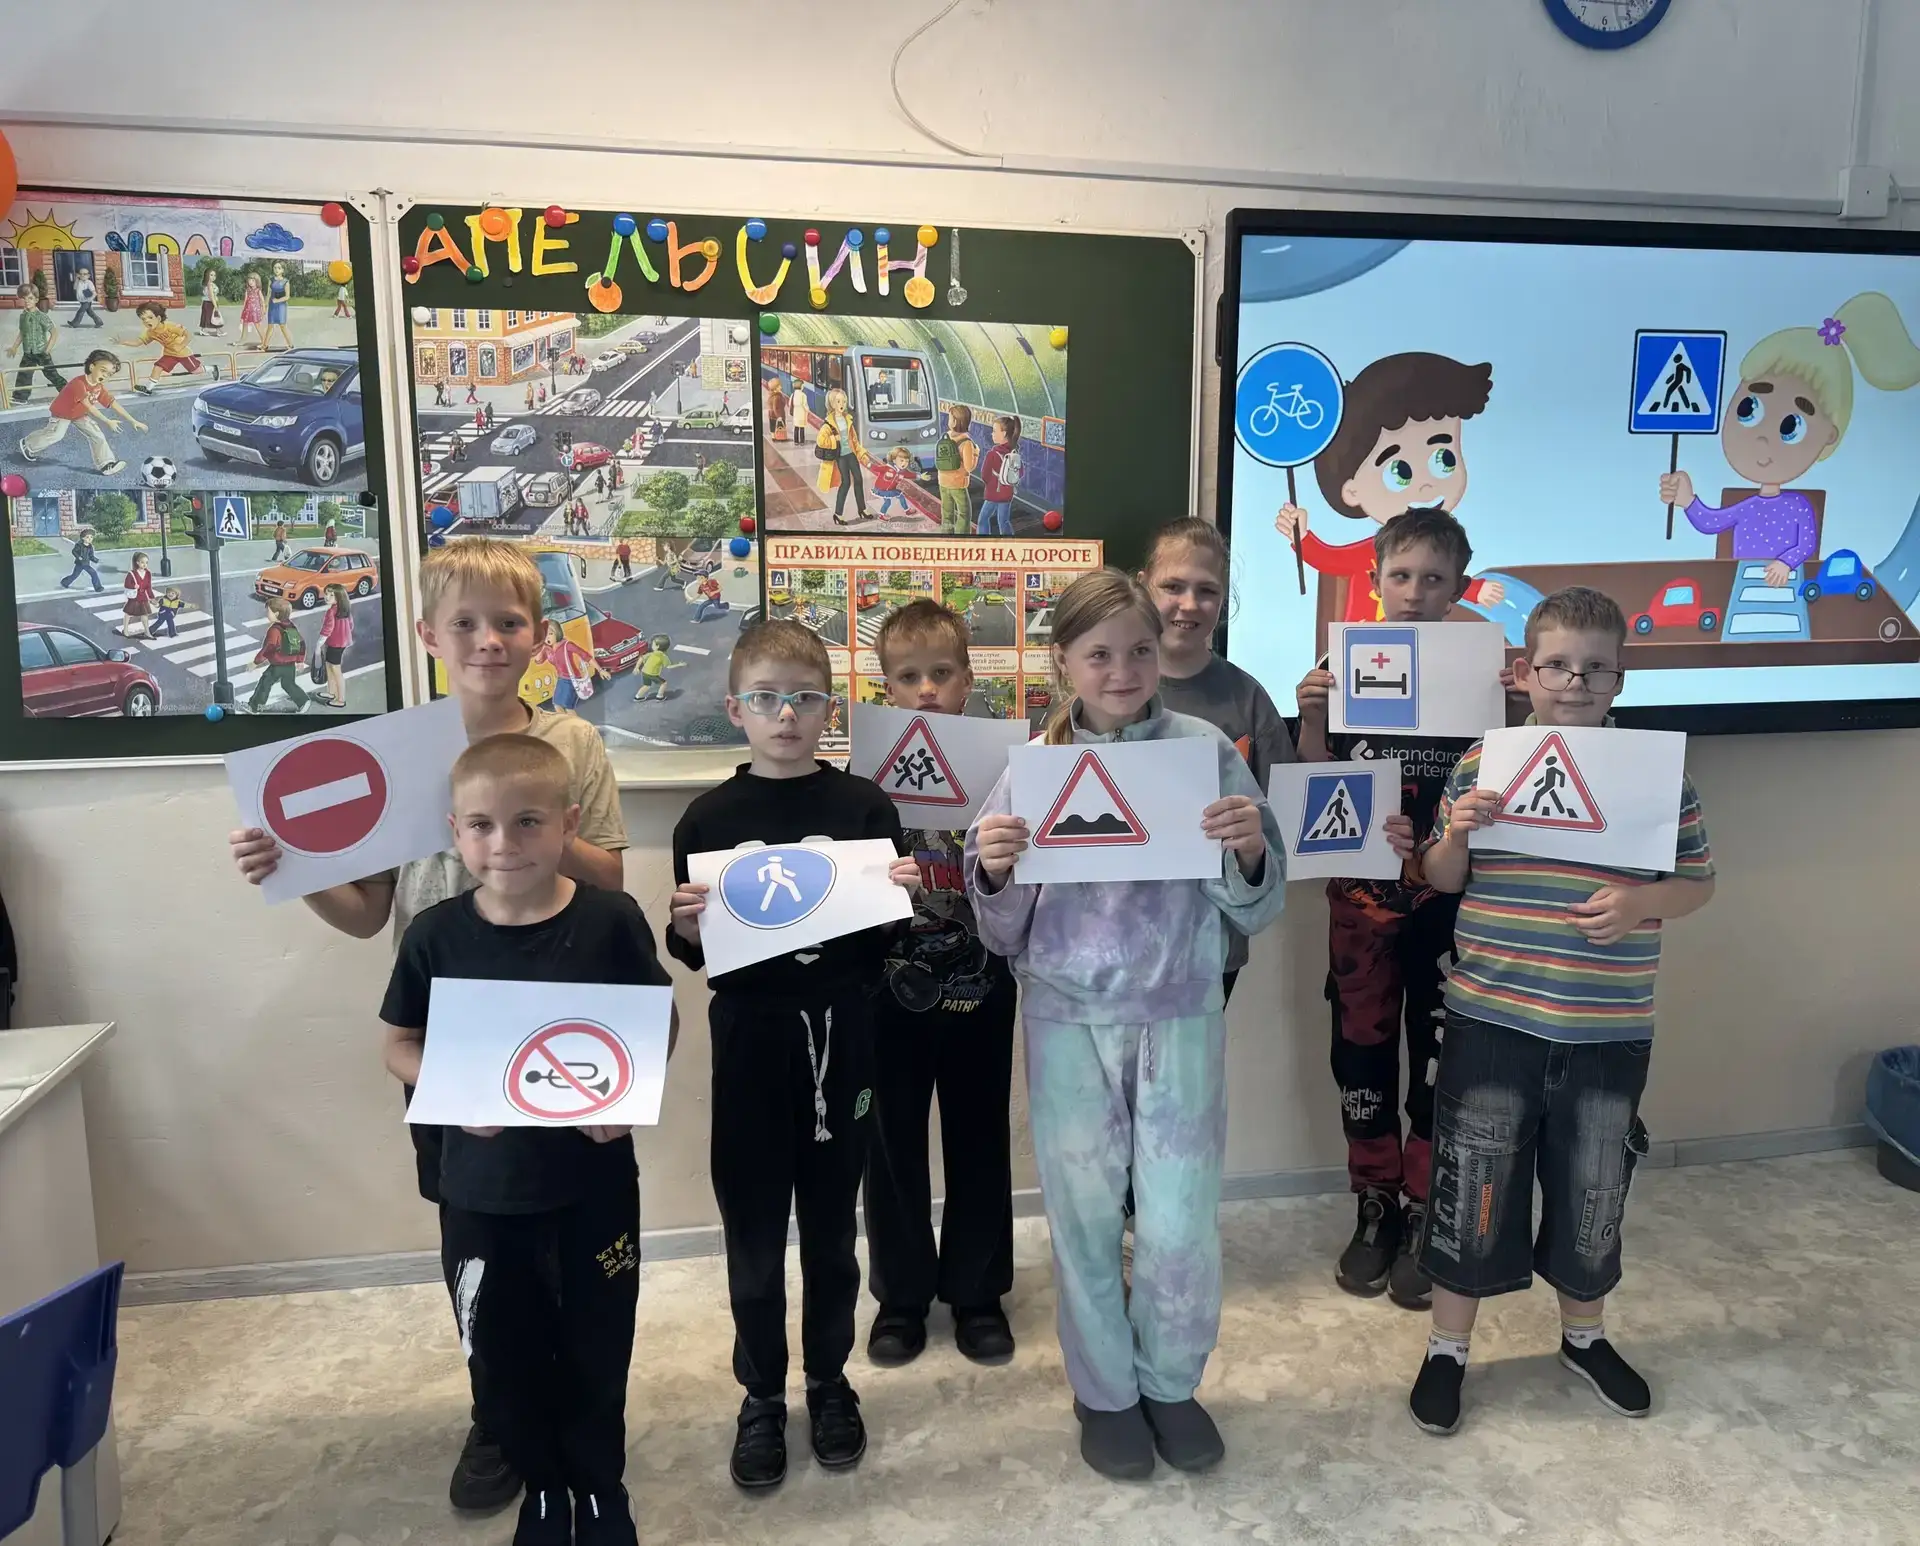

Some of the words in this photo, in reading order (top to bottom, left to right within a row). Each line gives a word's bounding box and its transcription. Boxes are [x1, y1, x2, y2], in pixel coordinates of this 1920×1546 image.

[1581, 6, 1587, 16] 7
[1601, 16, 1608, 26] 6
[774, 544, 867, 561] ПРАВИЛА
[872, 546, 986, 564] ПОВЕДЕНИЯ
[991, 547, 1017, 562] НА
[1021, 548, 1091, 565] ДОРОГЕ
[1381, 746, 1464, 764] standard
[1402, 762, 1453, 778] artere
[854, 1087, 872, 1120] G
[595, 1245, 614, 1262] SET
[603, 1256, 618, 1270] ON
